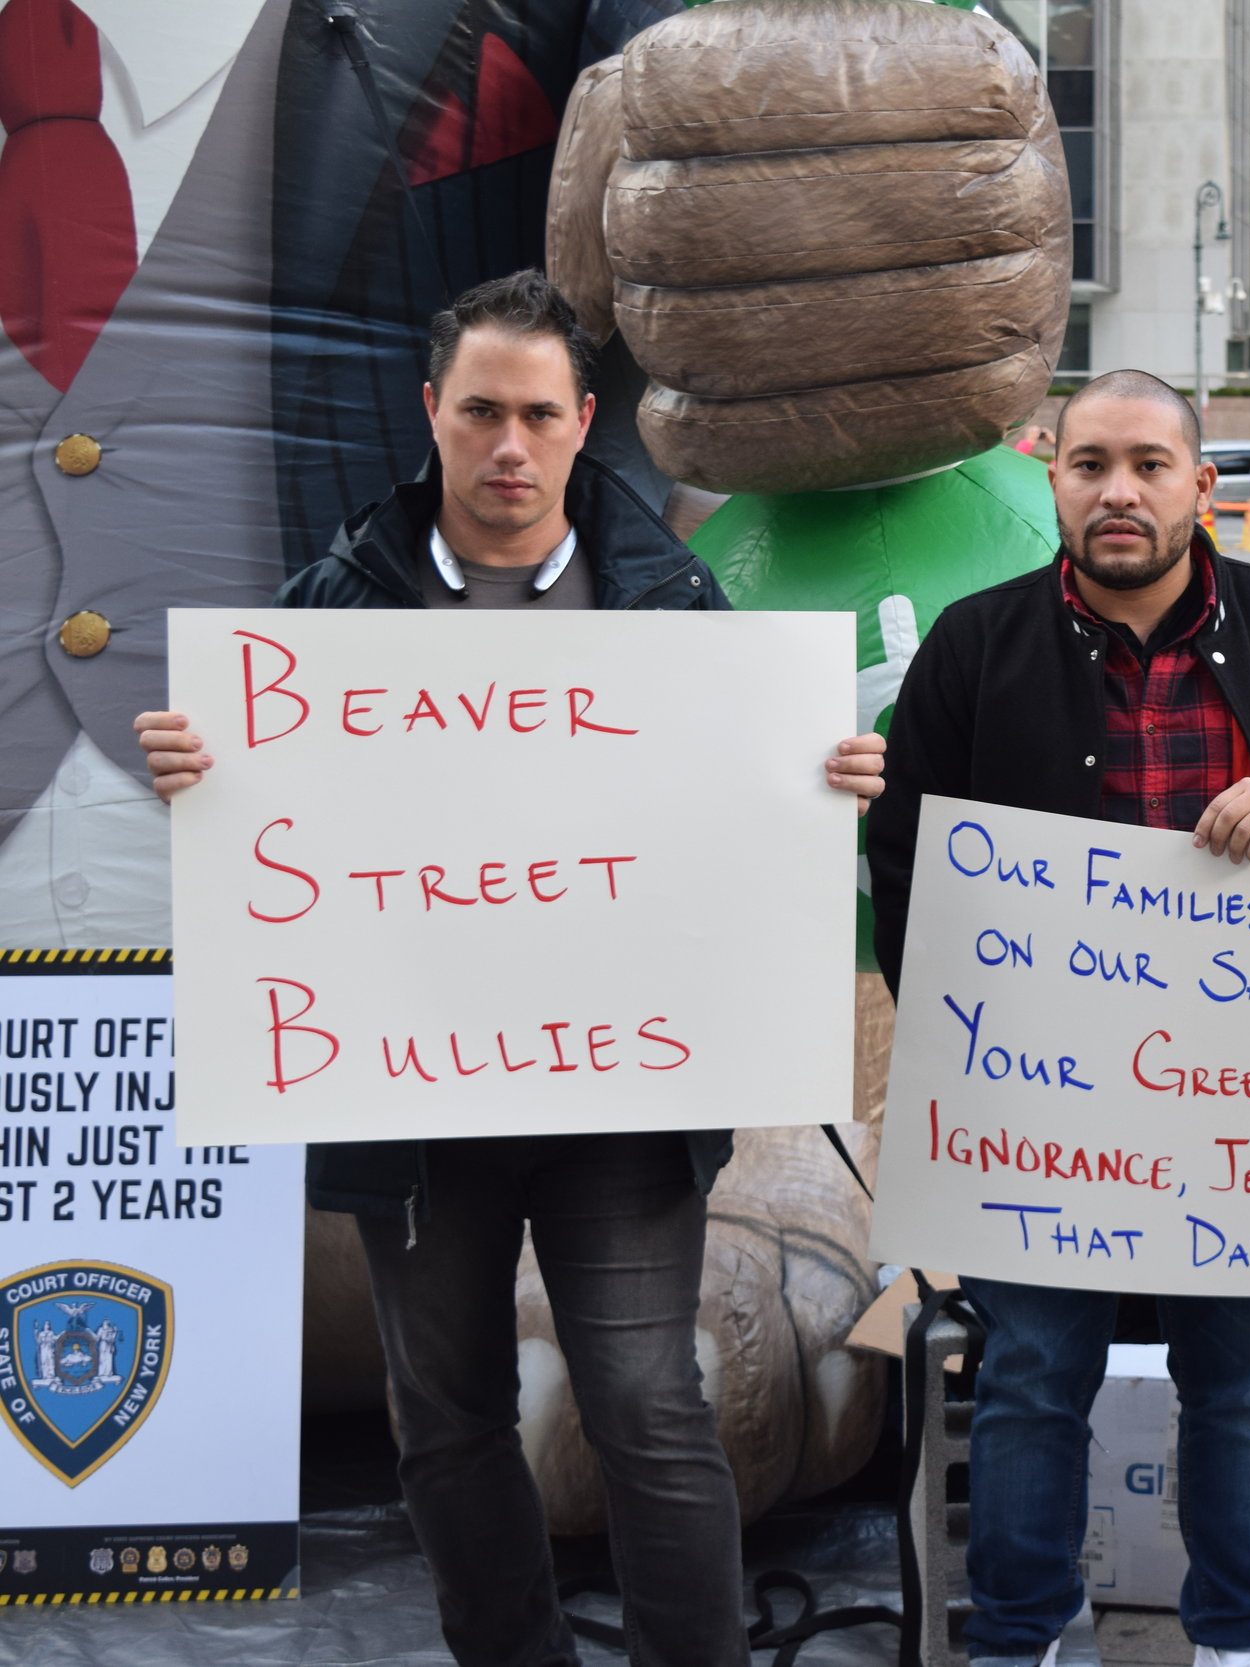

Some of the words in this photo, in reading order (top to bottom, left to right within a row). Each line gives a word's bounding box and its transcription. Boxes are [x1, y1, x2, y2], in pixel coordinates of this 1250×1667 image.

[231, 629, 640, 749] BEAVER
[247, 817, 638, 924] STREET
[947, 820, 1056, 890] OUR
[975, 928, 1033, 969] ON
[1068, 939, 1169, 989] OUR
[0, 1018, 79, 1058] URT
[255, 976, 691, 1095] BULLIES
[942, 993, 1095, 1091] YOUR
[0, 1071, 100, 1112] USLY
[67, 1125, 163, 1166] JUST
[929, 1099, 1187, 1198] IGNORANCE,
[53, 1180, 75, 1221] 2
[92, 1178, 222, 1220] YEARS
[980, 1201, 1144, 1260] THAT
[6, 1273, 68, 1304] COURT
[73, 1272, 152, 1304] OFFICER
[0, 1327, 17, 1391] STATE
[11, 1398, 36, 1424] OF
[113, 1383, 148, 1426] NEW
[140, 1324, 162, 1377] YORK
